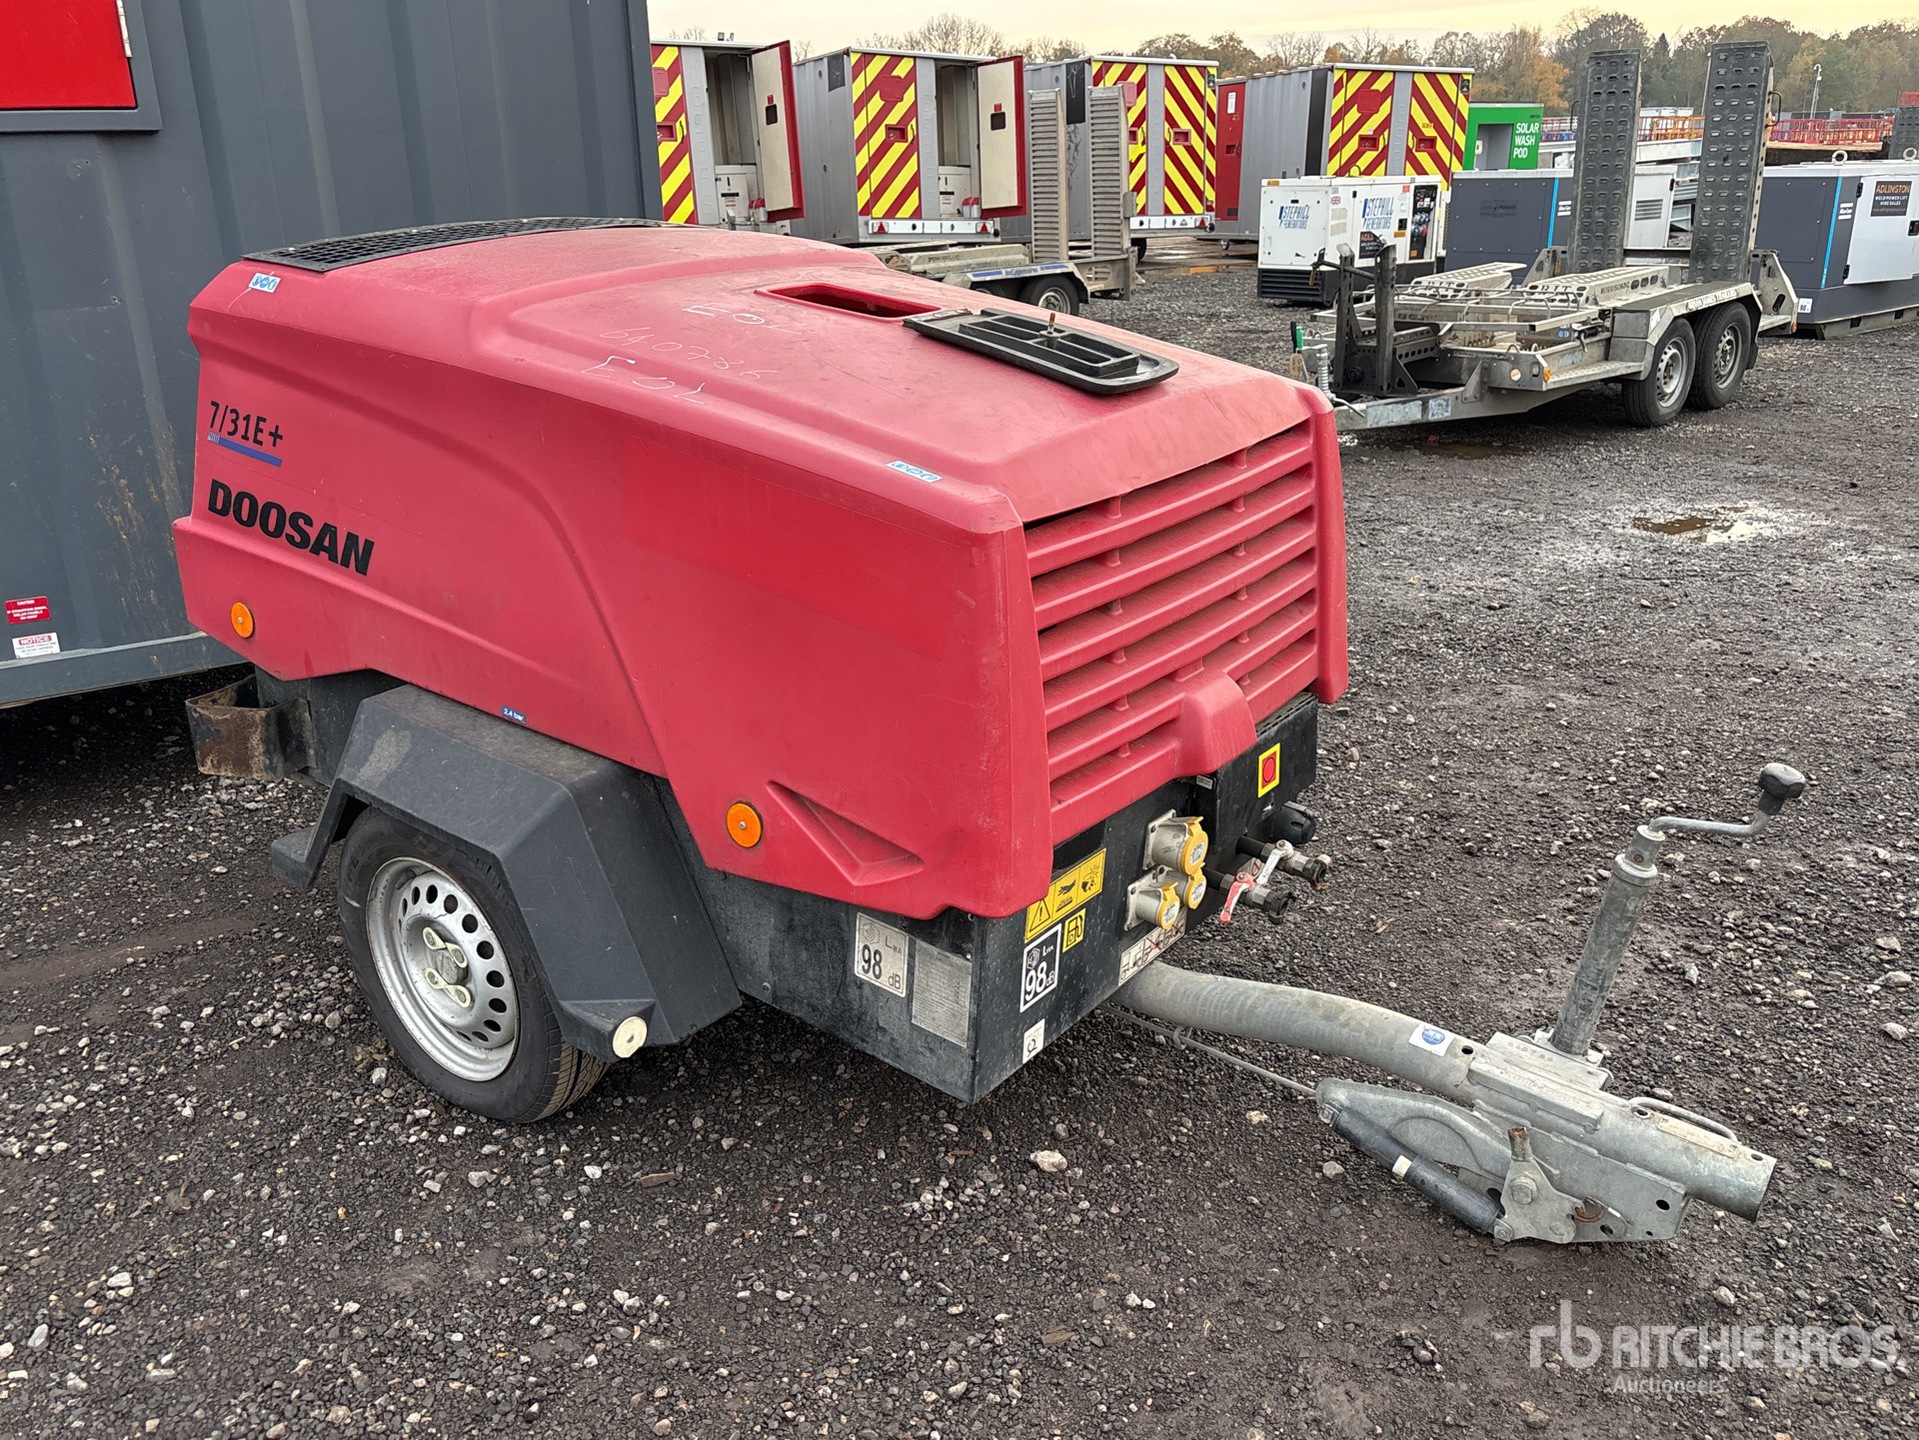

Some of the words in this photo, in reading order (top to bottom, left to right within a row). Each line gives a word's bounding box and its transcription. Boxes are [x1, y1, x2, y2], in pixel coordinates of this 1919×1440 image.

[1515, 122, 1540, 134] SOLAR
[1514, 134, 1536, 147] WASH
[1513, 147, 1528, 159] POD
[1876, 185, 1910, 194] ADLINGTON
[210, 400, 284, 447] 7/31E+
[208, 478, 376, 577] DOOSAN
[20, 635, 50, 646] NOTICE
[862, 943, 882, 980] 98
[888, 971, 901, 990] dB
[1025, 960, 1048, 1002] 98
